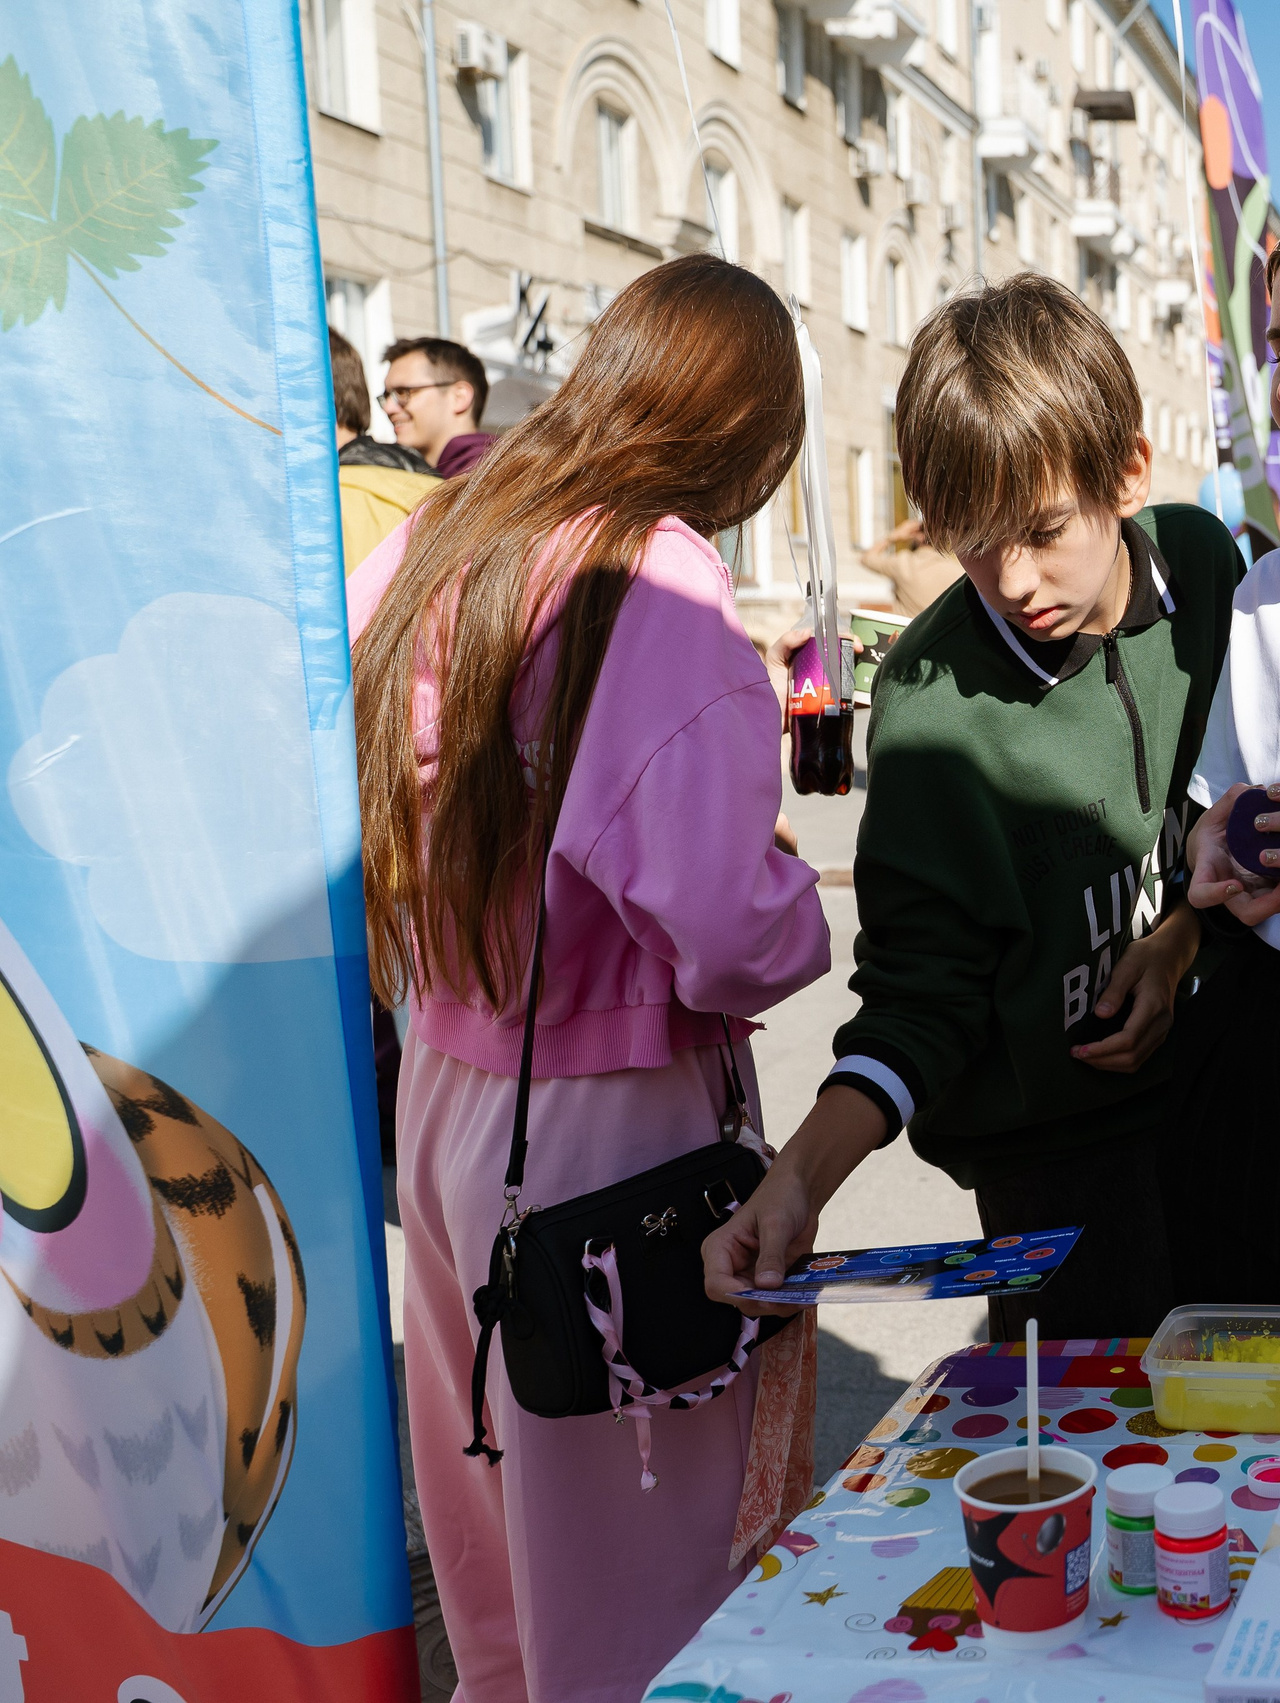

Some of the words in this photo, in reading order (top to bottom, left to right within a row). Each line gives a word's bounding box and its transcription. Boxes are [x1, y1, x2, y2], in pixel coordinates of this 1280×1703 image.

[1012, 819, 1049, 850] NOT
[1054, 798, 1107, 836] DOUBT
[1020, 848, 1057, 889] JUST
[1060, 835, 1118, 861] CREATE
